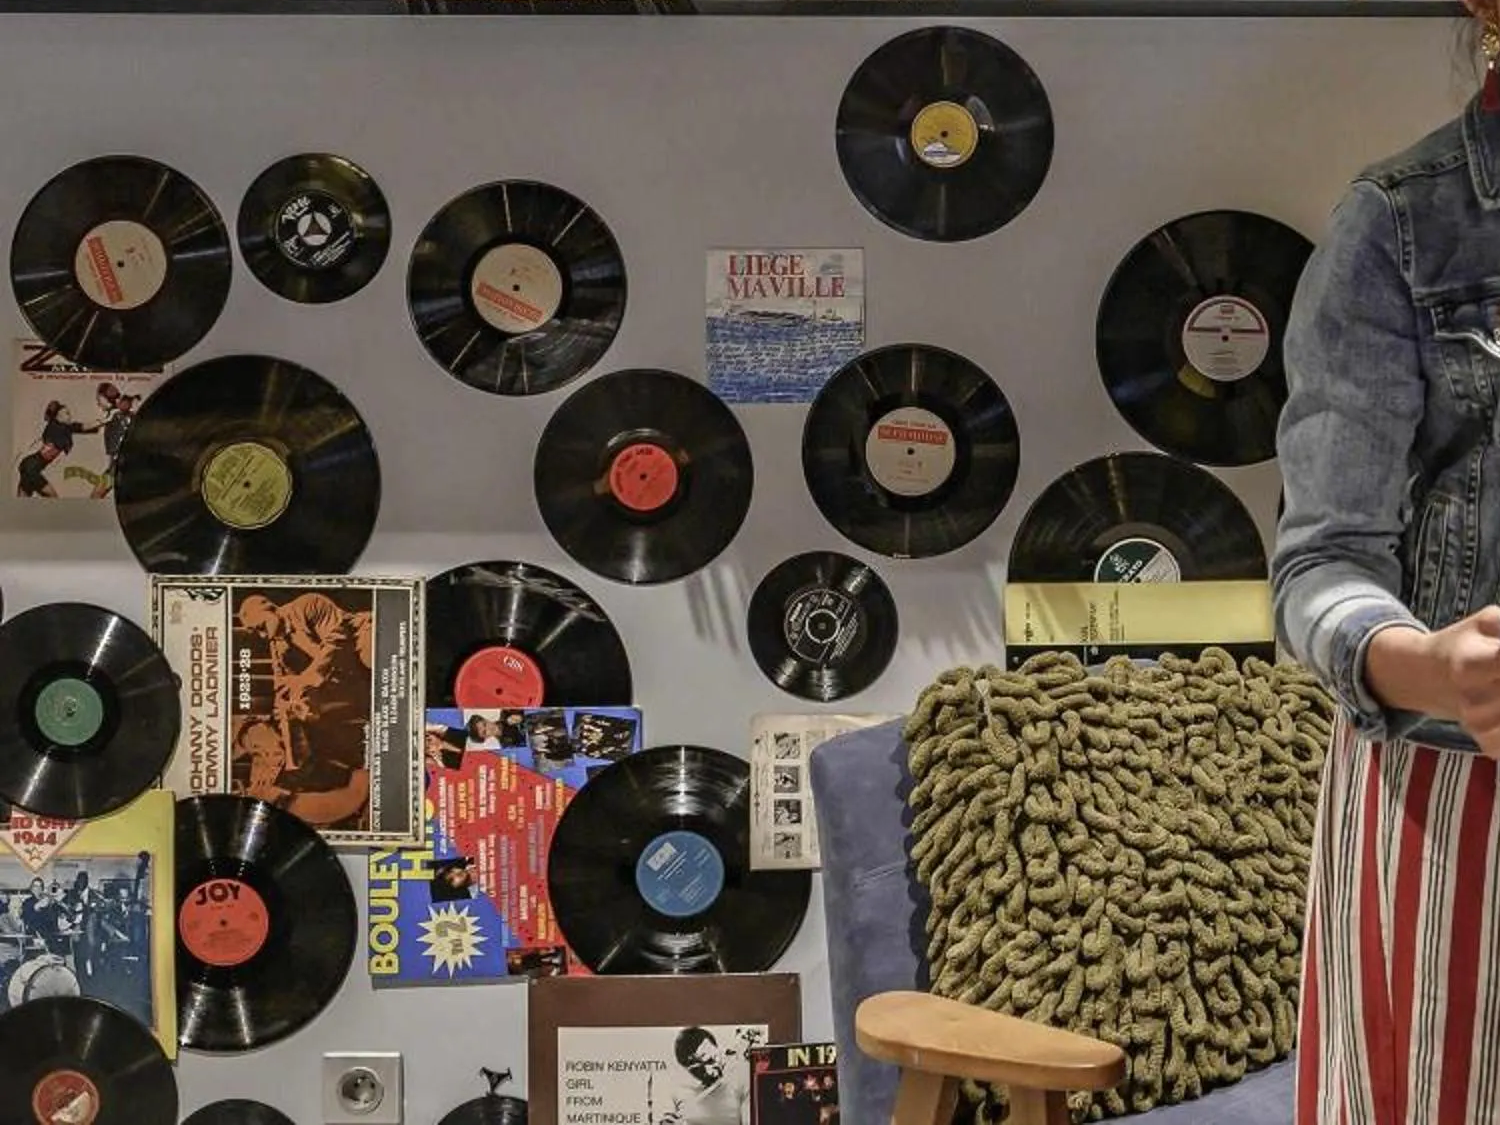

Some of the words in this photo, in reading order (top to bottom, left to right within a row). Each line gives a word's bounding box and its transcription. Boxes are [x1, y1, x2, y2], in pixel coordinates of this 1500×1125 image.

[728, 254, 804, 276] LIEGE
[204, 627, 218, 718] LADNIER
[204, 725, 218, 794] OMMY
[13, 831, 57, 846] 1944
[195, 882, 241, 906] JOY
[787, 1046, 811, 1067] IN
[565, 1061, 604, 1072] ROBIN
[607, 1060, 668, 1072] KENYATTA
[565, 1079, 594, 1090] GIRL
[565, 1096, 603, 1107] FROM
[565, 1113, 641, 1124] MARTINIQUE
